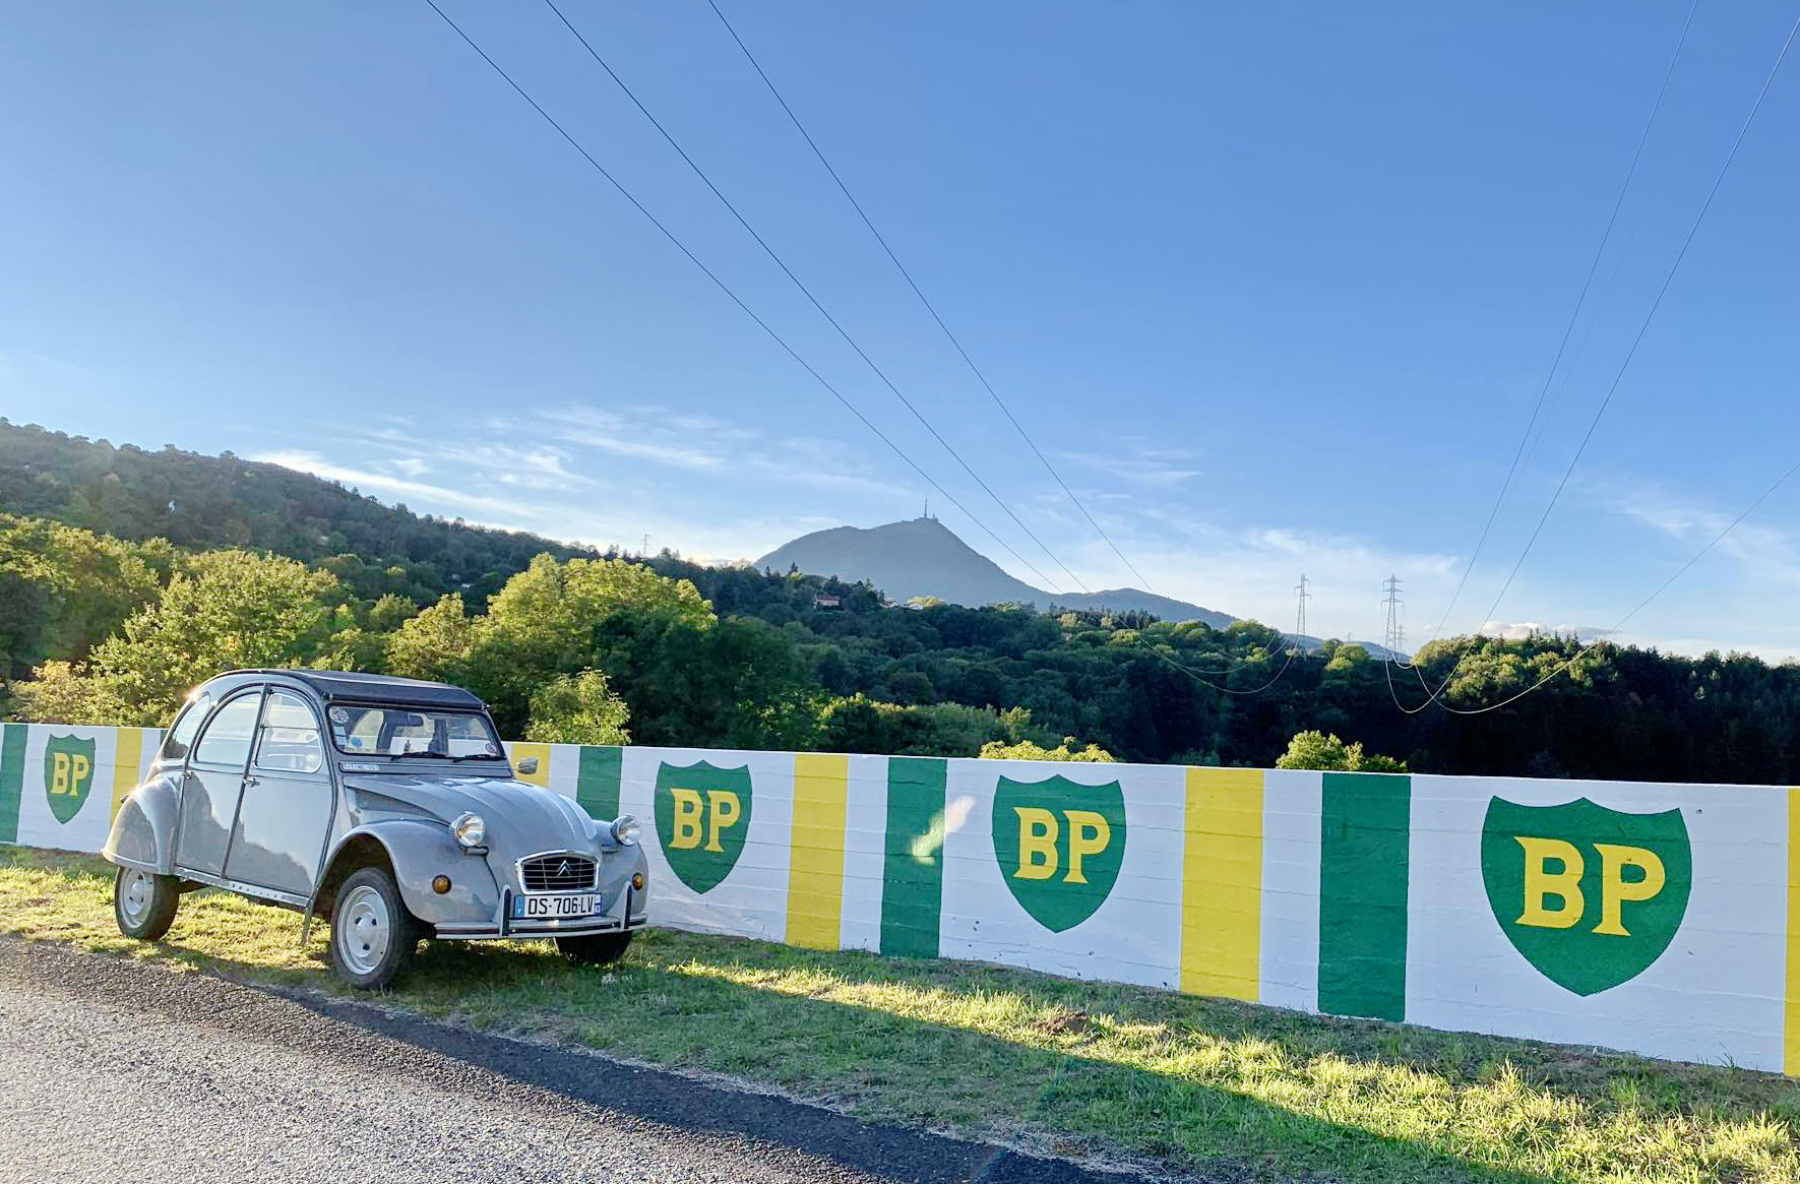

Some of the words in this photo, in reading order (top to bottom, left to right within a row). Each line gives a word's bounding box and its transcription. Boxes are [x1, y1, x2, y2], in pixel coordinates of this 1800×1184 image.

[52, 752, 90, 796] BP
[669, 788, 741, 852] BP
[1013, 807, 1110, 884] BP
[1514, 836, 1666, 936] BP
